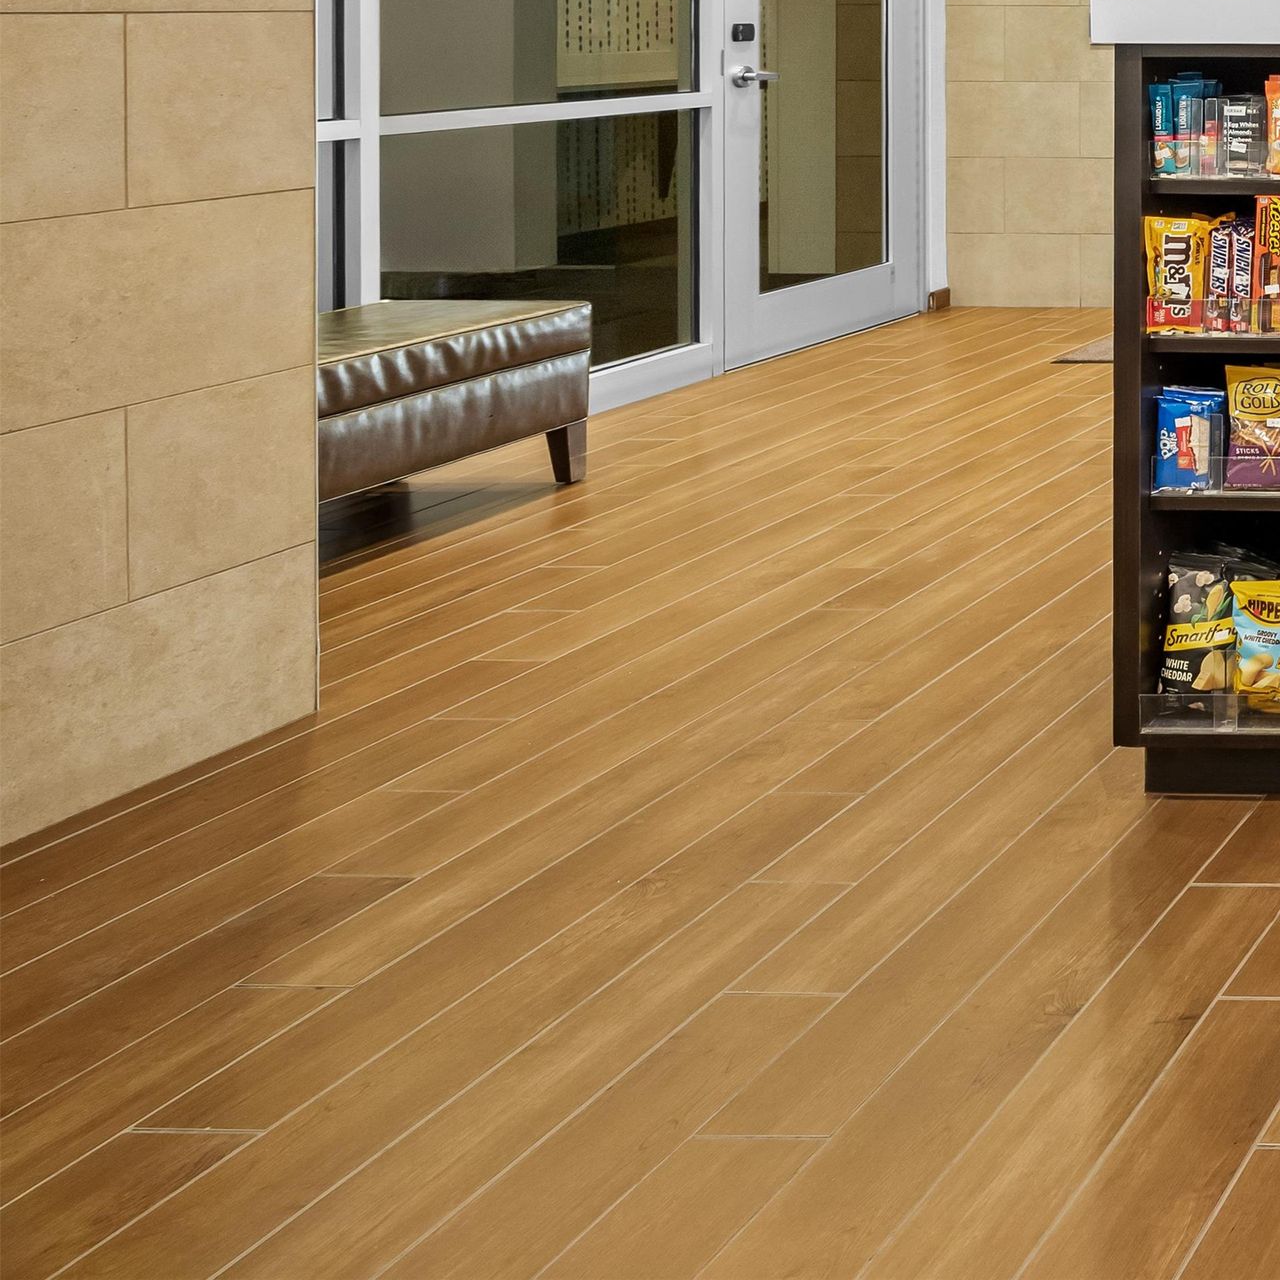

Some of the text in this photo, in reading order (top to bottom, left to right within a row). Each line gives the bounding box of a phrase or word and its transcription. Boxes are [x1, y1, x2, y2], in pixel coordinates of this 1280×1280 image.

[1179, 109, 1187, 129] LIQUID
[1212, 234, 1228, 292] SNICKRS
[1235, 237, 1251, 297] SNICKS
[1165, 234, 1192, 318] m&m's
[1241, 397, 1280, 409] GOLD
[1236, 447, 1260, 455] STICKS
[1167, 623, 1237, 647] Smartf
[1244, 634, 1261, 643] WHITE
[1257, 630, 1278, 639] GROOVY
[1166, 658, 1189, 669] WHITE
[1161, 668, 1193, 683] CHEDDAR
